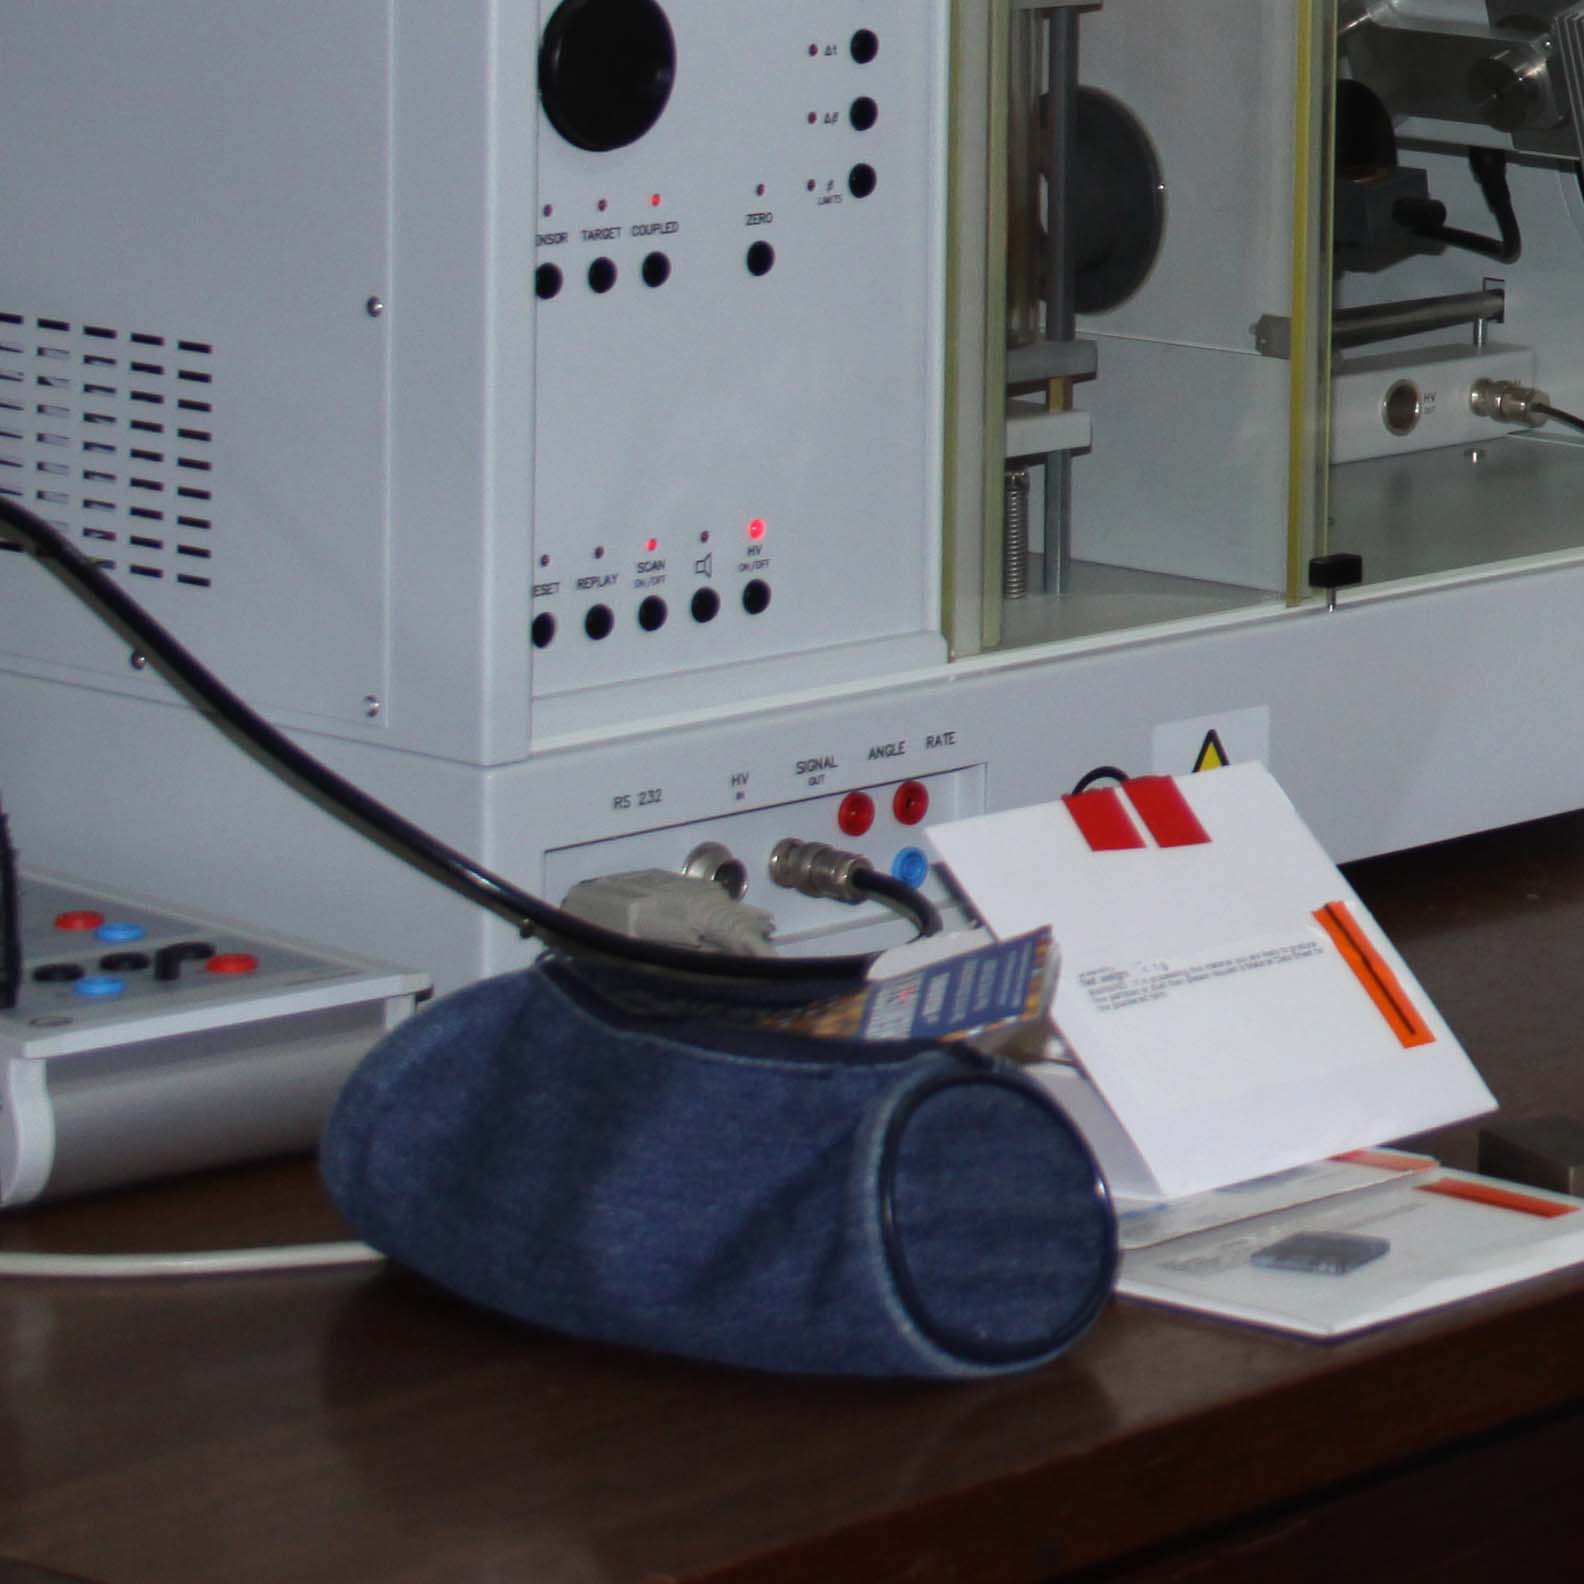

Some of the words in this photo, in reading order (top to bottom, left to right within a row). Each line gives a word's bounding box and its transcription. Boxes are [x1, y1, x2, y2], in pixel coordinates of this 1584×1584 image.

[745, 212, 774, 226] ZERO
[582, 227, 623, 241] TARGET
[631, 221, 680, 237] COUPLED
[747, 545, 762, 556] HV
[637, 560, 666, 574] SCAN
[532, 582, 560, 597] ESET
[577, 574, 619, 590] REPLAY
[926, 731, 956, 750] RATE
[868, 740, 906, 761] ANGLE
[795, 756, 839, 775] SIGNAL
[731, 772, 750, 787] HV
[613, 795, 631, 810] RS
[638, 789, 663, 806] 232
